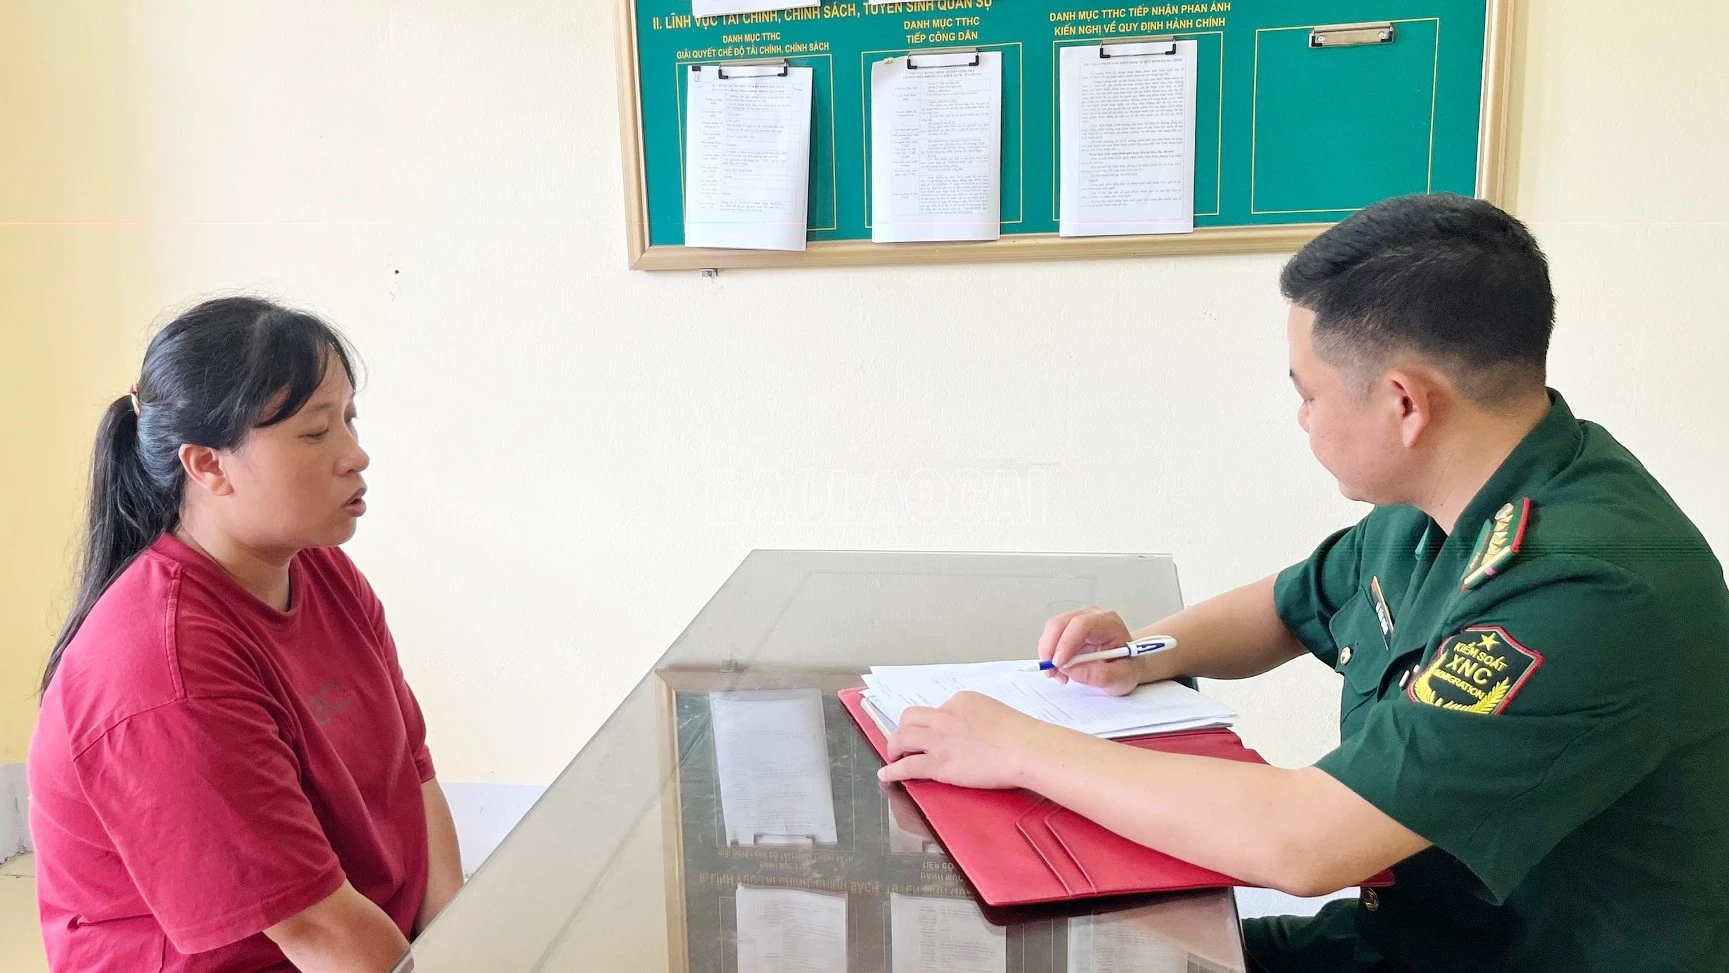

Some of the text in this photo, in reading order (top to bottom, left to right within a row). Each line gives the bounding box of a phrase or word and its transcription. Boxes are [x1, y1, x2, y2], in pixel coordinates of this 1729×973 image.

[652, 16, 663, 30] II.
[665, 12, 691, 29] LĨNH
[823, 2, 860, 19] SÁCH,
[906, 1, 934, 13] SINH
[1049, 11, 1076, 22] DANH
[1078, 10, 1100, 22] MỤC
[1101, 8, 1126, 19] TTHC
[1128, 4, 1150, 17] TIẾP
[1151, 3, 1179, 17] NHẬN
[1209, 0, 1232, 12] ÁNH
[903, 16, 980, 30] DANH MỤC TTHC
[1054, 22, 1076, 36] KIẾN
[1078, 23, 1102, 36] NGHỊ
[1118, 22, 1139, 33] QUY
[1140, 20, 1164, 33] ĐỊNH
[1165, 17, 1193, 30] HÀNH
[1195, 15, 1226, 29] CHÍNH
[722, 31, 781, 44] DANH MỤC TTHC
[906, 29, 978, 44] TIẾP CÔNG DÂN
[692, 46, 717, 58] QUYẾT
[717, 45, 733, 57] CHẾ
[734, 45, 745, 58] ĐỘ
[746, 44, 758, 55] TÀI
[784, 41, 808, 53] CHÍNH
[808, 40, 830, 52] SÁCH
[1445, 654, 1493, 685] XNC
[1476, 655, 1509, 673] SOÁT
